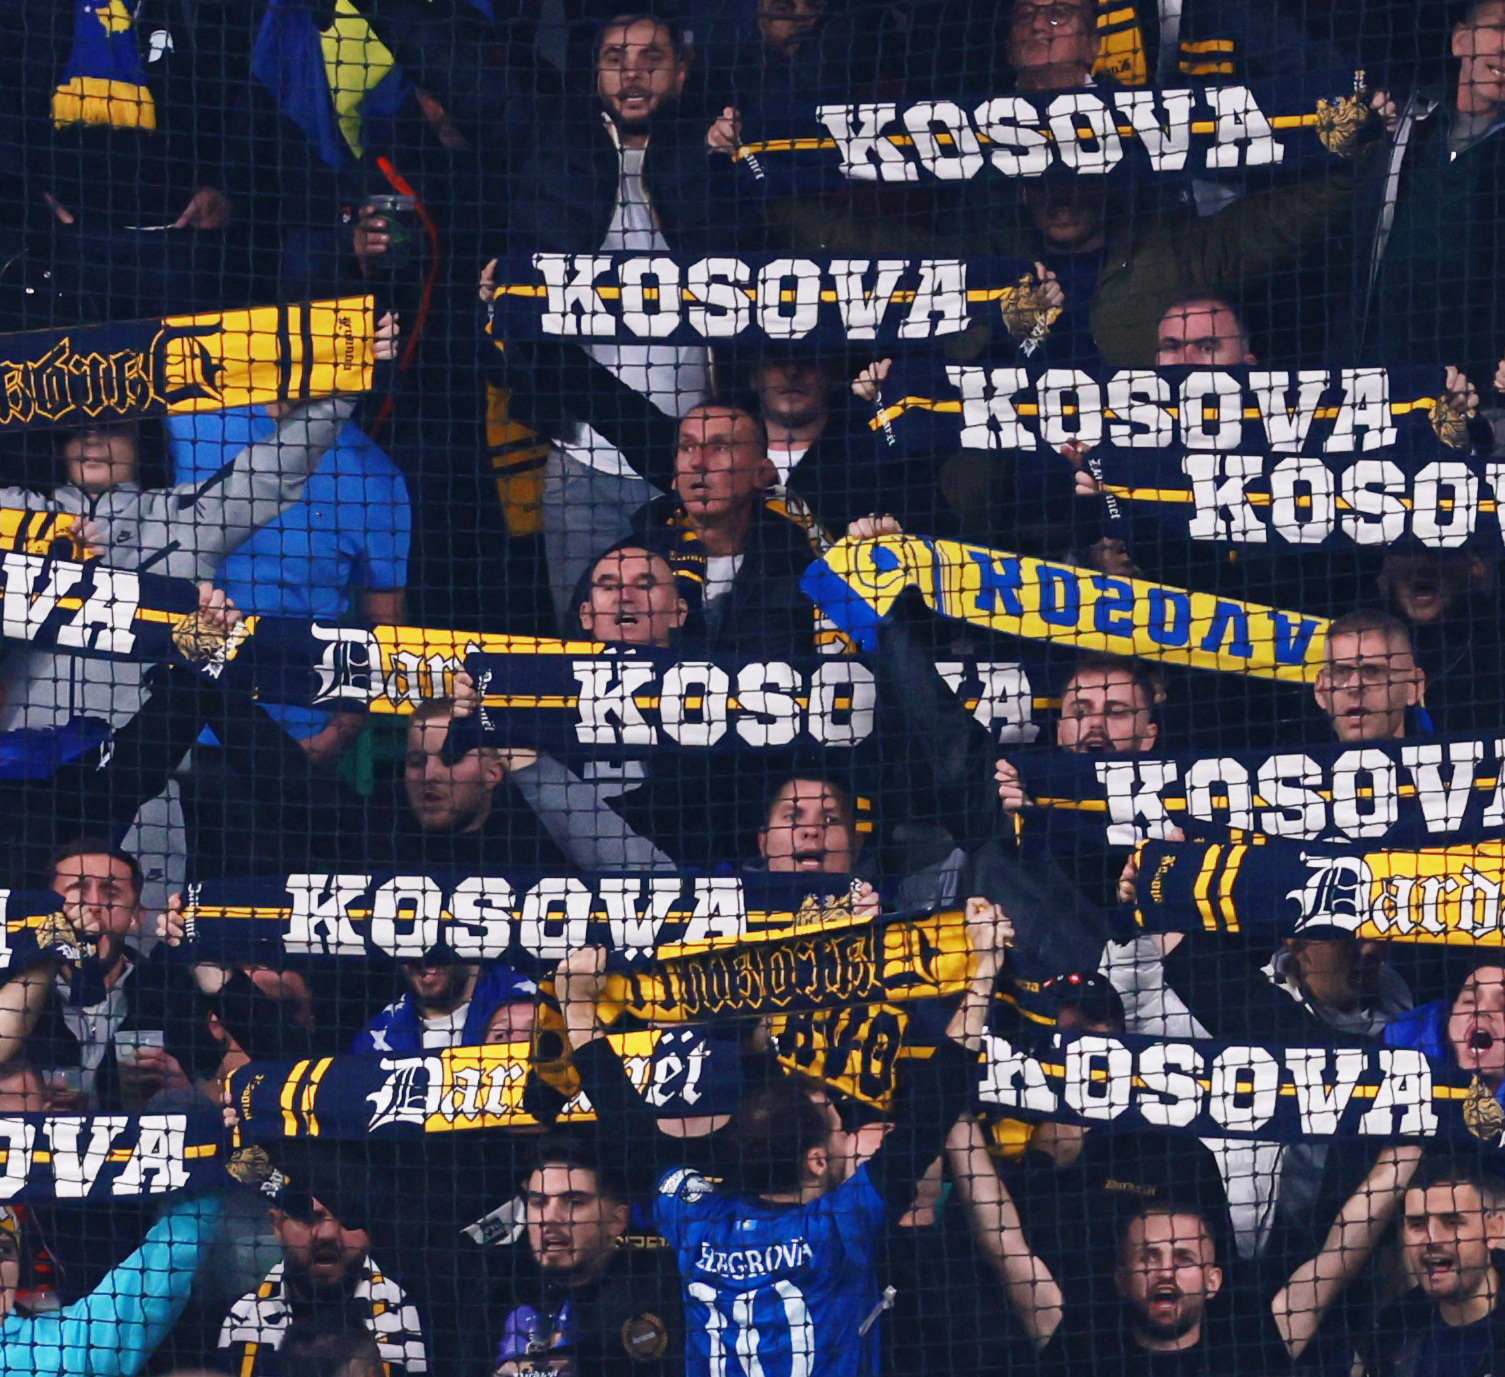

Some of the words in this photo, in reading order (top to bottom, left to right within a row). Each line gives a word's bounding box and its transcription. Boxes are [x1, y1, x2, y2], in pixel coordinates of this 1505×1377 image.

[817, 85, 1284, 183] KOSOVA
[532, 253, 971, 340] KOSOVA
[946, 365, 1397, 453] KOSOVA
[285, 873, 749, 959] KOSOVA
[977, 1026, 1439, 1138] KOSOVA
[688, 1279, 815, 1377] 10
